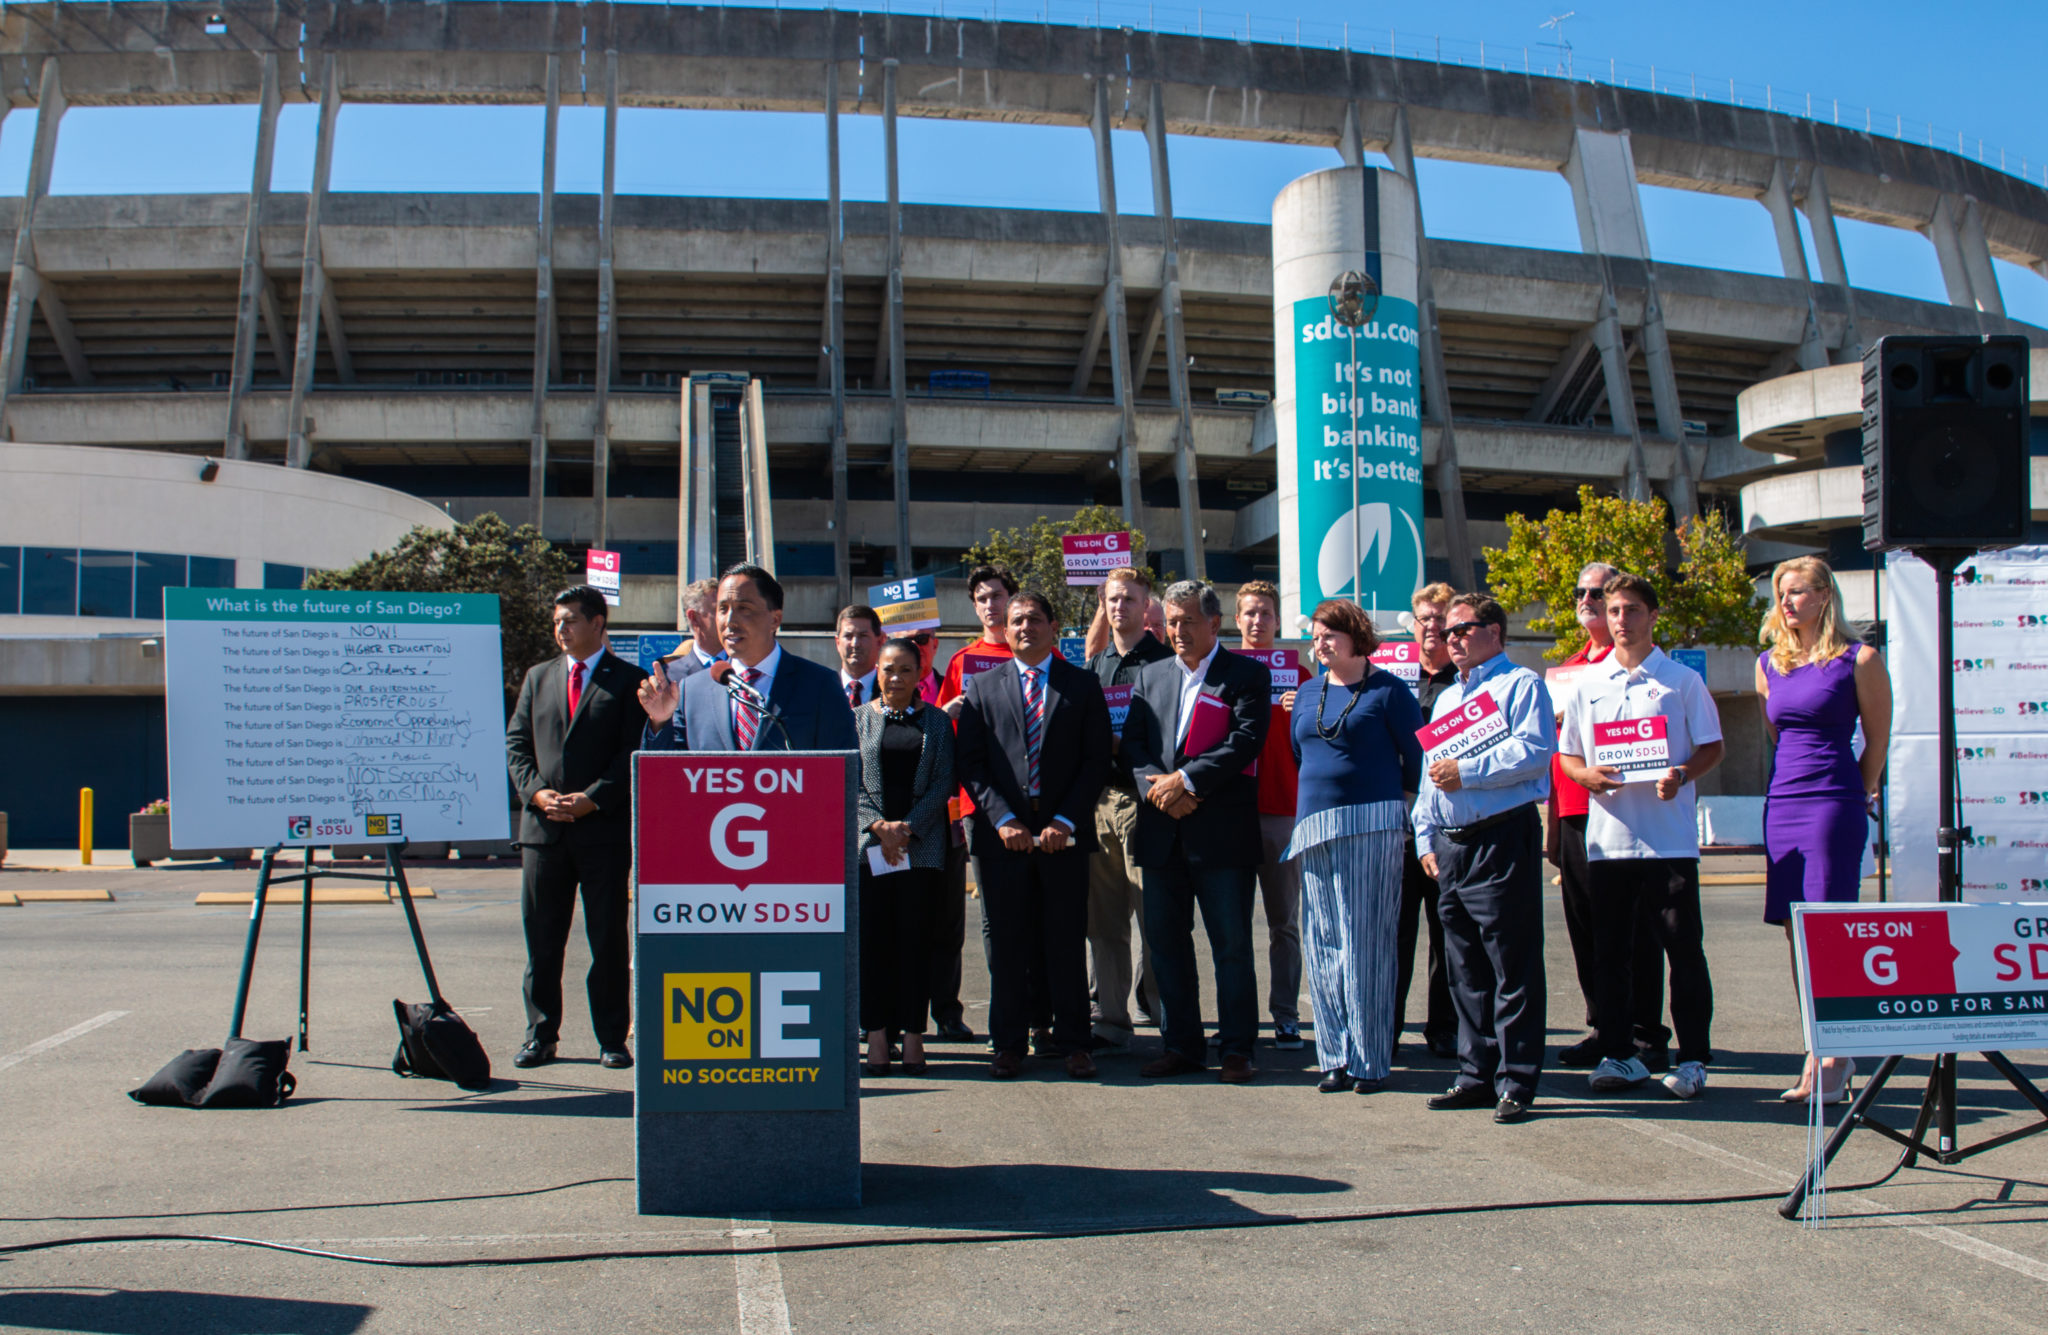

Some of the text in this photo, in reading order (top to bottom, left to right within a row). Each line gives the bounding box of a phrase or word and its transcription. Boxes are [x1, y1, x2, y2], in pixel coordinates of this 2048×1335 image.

[1335, 361, 1412, 388] It's not
[1322, 392, 1418, 420] big bank
[1324, 425, 1420, 456] banking.
[1314, 457, 1422, 484] It's better.
[1104, 535, 1118, 550] G
[605, 553, 614, 570] G
[1067, 556, 1129, 566] GROW SDSU
[883, 578, 920, 600] NO E
[206, 598, 462, 619] What is the future of San Diego?
[223, 628, 338, 640] The future of San Diego is
[350, 625, 398, 639] NOW!
[223, 647, 339, 658] The future of San Diego is
[344, 643, 452, 656] HIGHER EDUCATION
[1395, 644, 1408, 661] G
[975, 661, 989, 669] YES
[1271, 651, 1285, 667] G
[223, 665, 339, 676] The future of San Diego is
[1274, 675, 1295, 683] DSU
[224, 684, 340, 694] The future of San Diego is
[1115, 691, 1128, 699] ON
[224, 703, 341, 713] The future of San Diego is
[225, 721, 333, 731] The future of San Diego
[1431, 701, 1483, 737] YES ON G
[1606, 719, 1653, 738] YES ON G
[225, 739, 343, 749] The future of San Diego is
[1433, 718, 1503, 761] GROW SDSU
[1474, 744, 1487, 753] SAN
[1488, 731, 1509, 745] DIEGO
[1599, 746, 1665, 760] GROW SDSU
[226, 757, 343, 768] The future of San Diego is
[227, 776, 344, 786] The future of San Diego is
[347, 766, 386, 785] NOT
[683, 768, 803, 794] YES ON
[228, 794, 345, 804] The future of San Diego is
[293, 821, 308, 837] G
[316, 825, 353, 836] SDSU
[369, 819, 384, 827] NO
[709, 802, 768, 870] G
[653, 902, 831, 924] GROW SDSU
[1844, 922, 1913, 938] YES ON
[2014, 917, 2048, 938] GR
[1863, 945, 1899, 986] G
[1993, 943, 2048, 982] SD
[672, 986, 744, 1024] NO
[1878, 996, 2044, 1014] GOOD FOR SAN
[760, 971, 820, 1058] E
[707, 1029, 744, 1048] ON
[663, 1067, 820, 1084] NO SOCCERCITY
